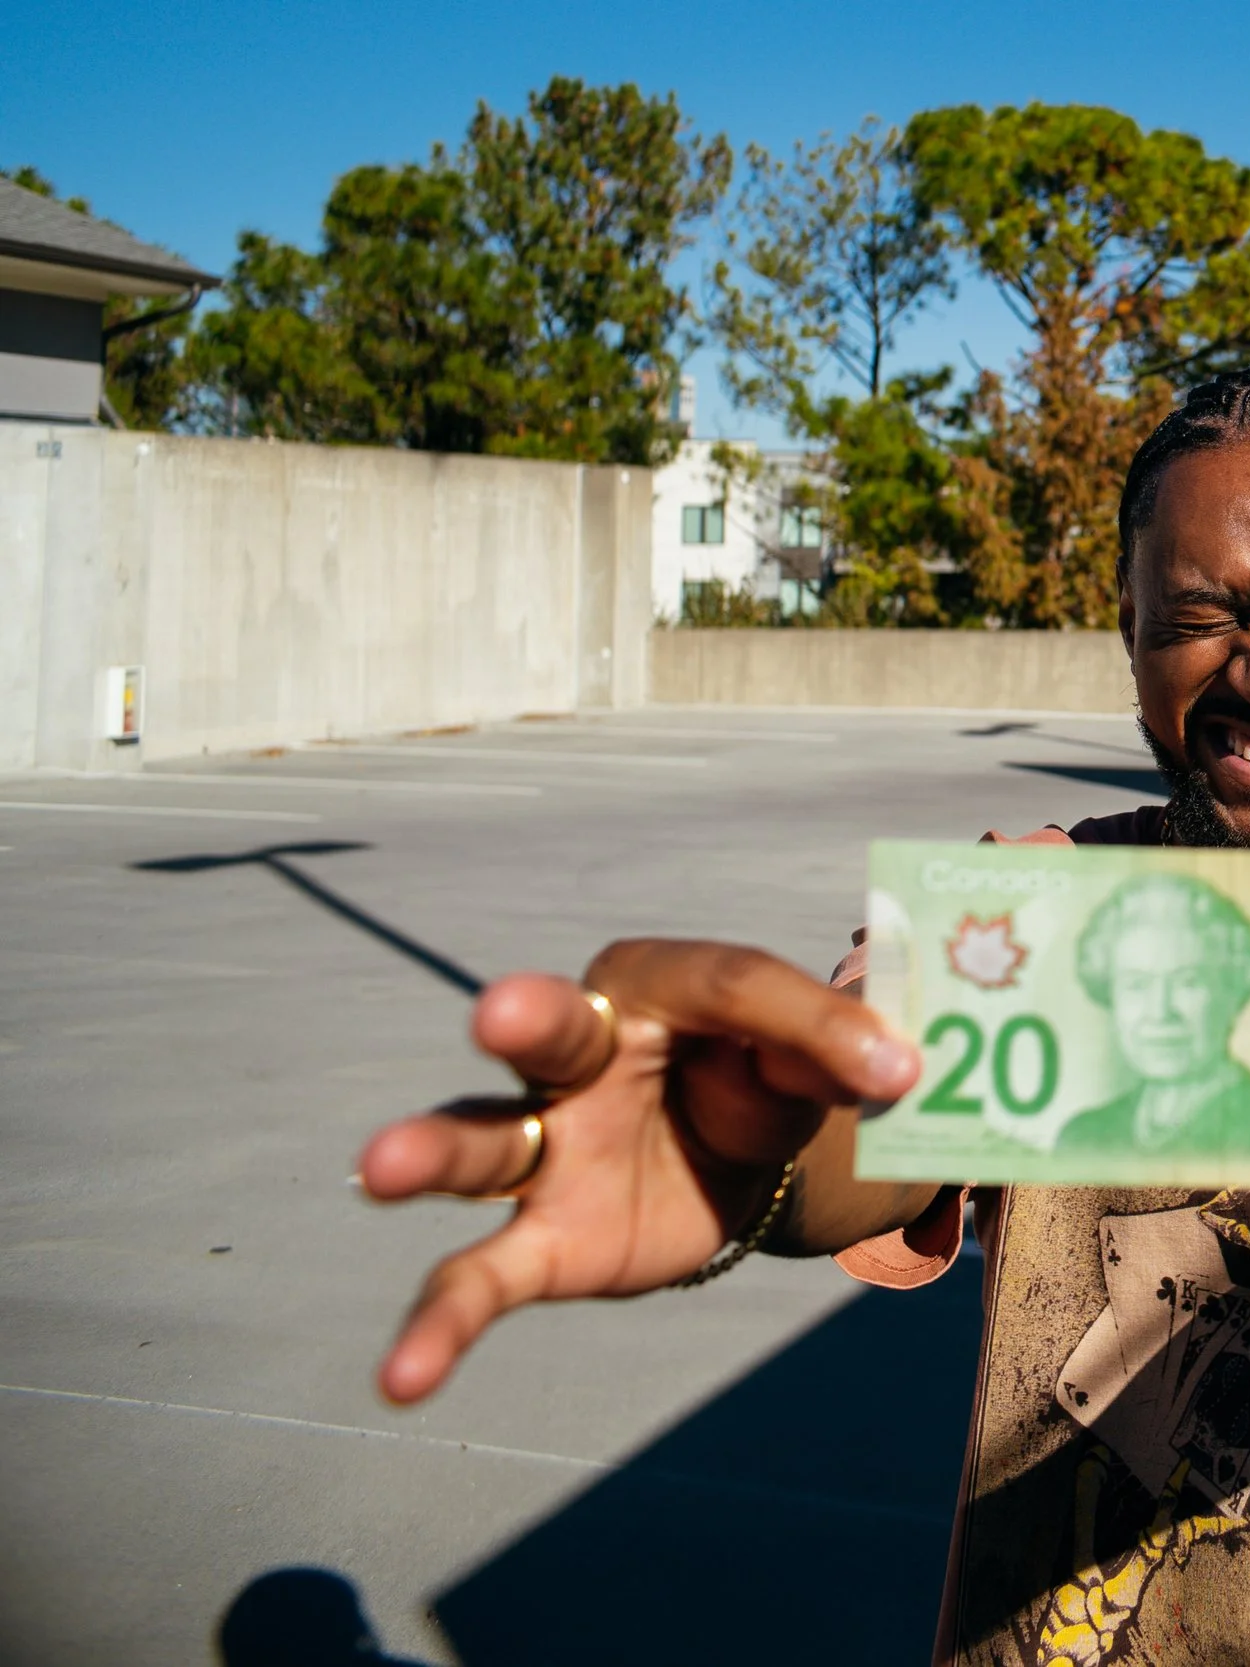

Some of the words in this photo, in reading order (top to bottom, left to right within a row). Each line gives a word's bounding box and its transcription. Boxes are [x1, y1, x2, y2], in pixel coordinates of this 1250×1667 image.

[921, 859, 1072, 895] Canada
[919, 1011, 1060, 1118] 20
[1106, 1228, 1116, 1248] A
[1182, 1279, 1197, 1300] K
[1063, 1381, 1076, 1401] A
